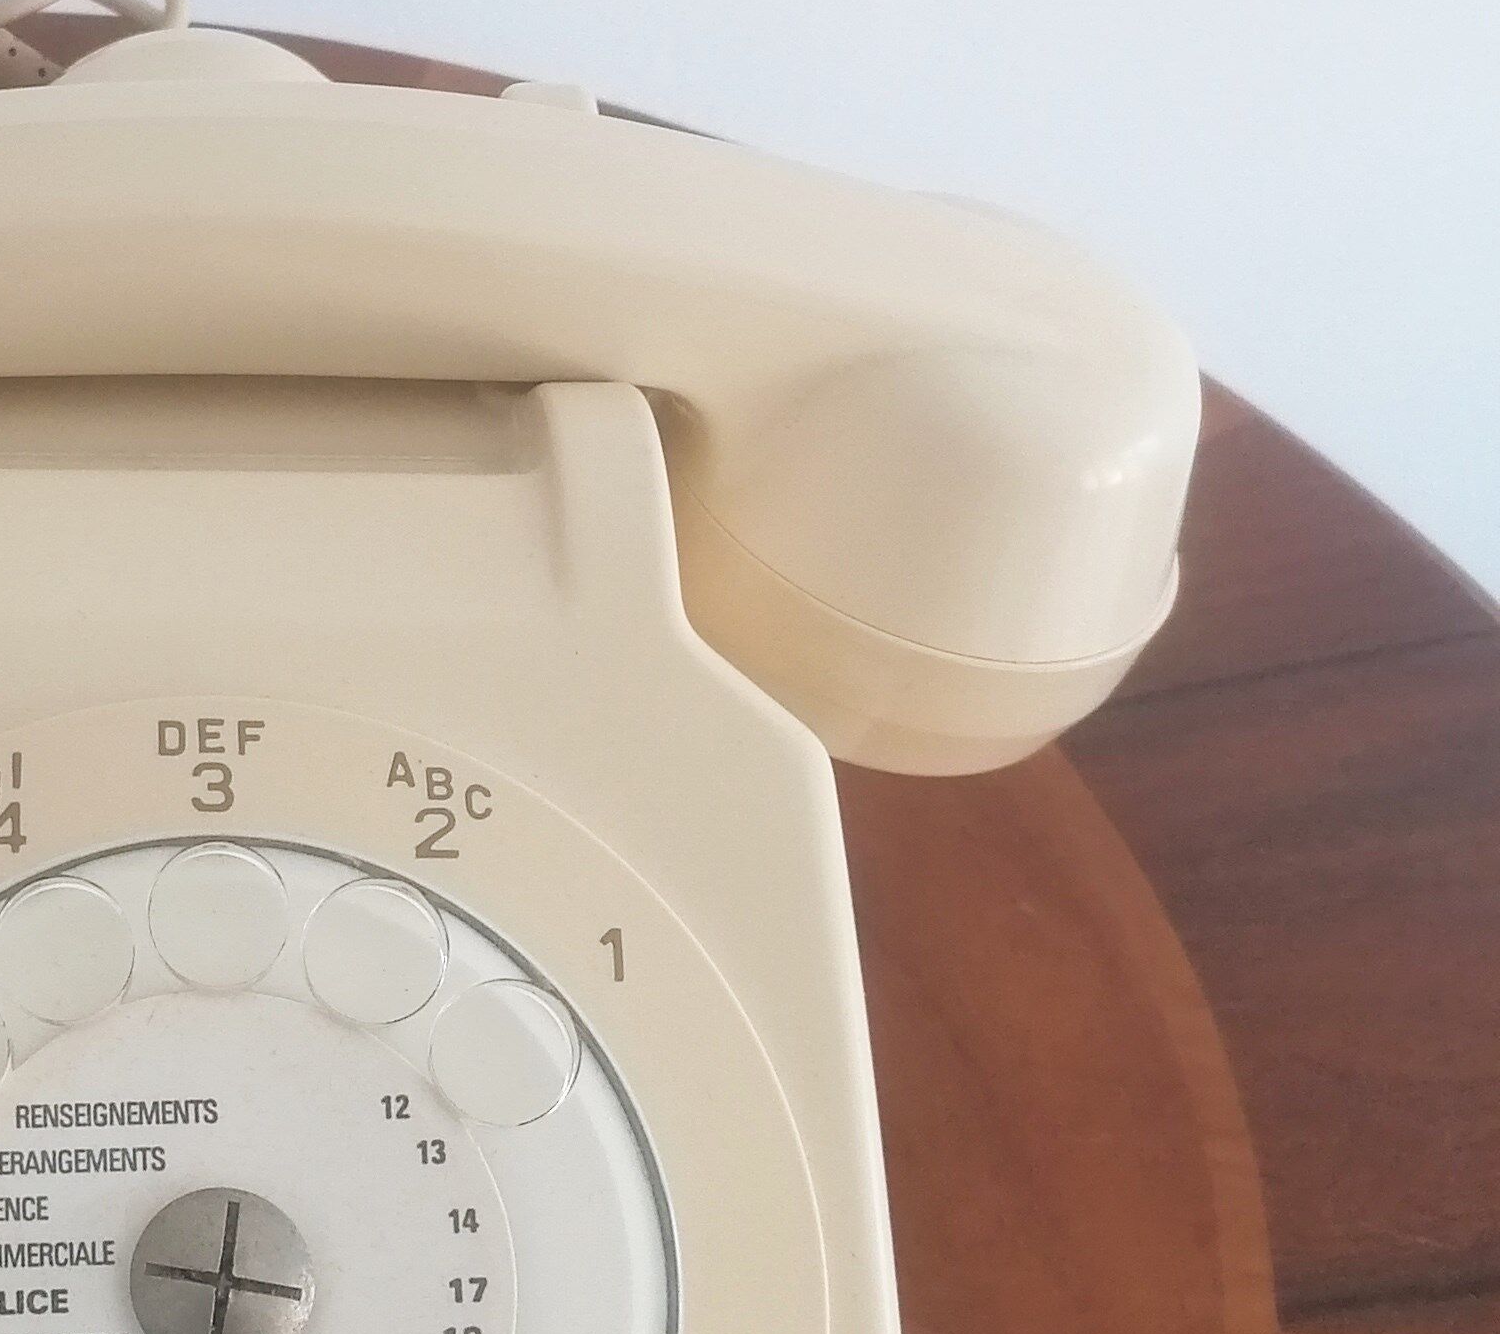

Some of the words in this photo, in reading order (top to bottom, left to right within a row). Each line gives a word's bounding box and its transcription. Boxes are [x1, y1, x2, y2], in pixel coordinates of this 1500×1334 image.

[158, 718, 265, 756] DEF
[191, 762, 235, 812] 3
[415, 808, 459, 859] 2
[600, 928, 624, 982] 1
[15, 1099, 219, 1129] RENSEIGNEMENTS
[381, 1095, 410, 1120] 12
[416, 1139, 447, 1165] 13
[448, 1208, 480, 1234] 14
[449, 1277, 488, 1304] 17
